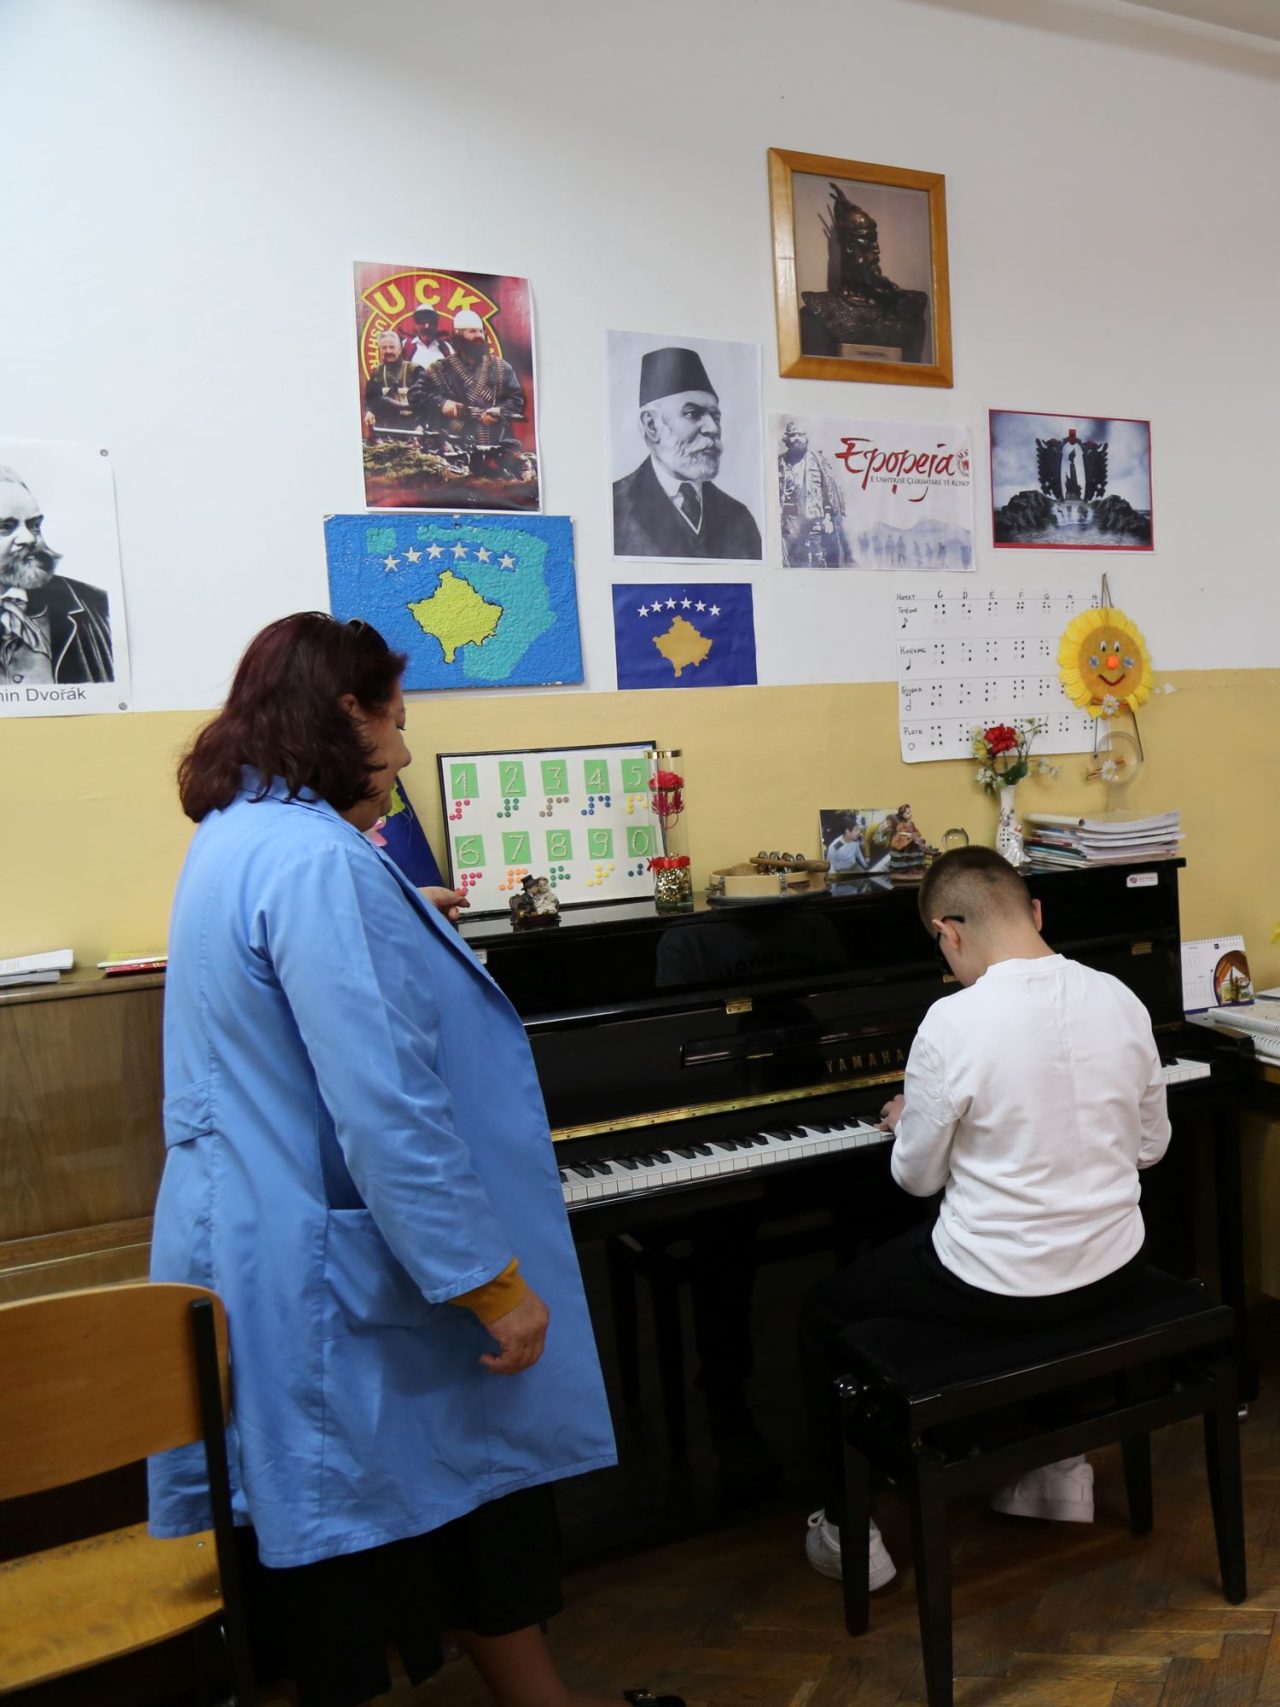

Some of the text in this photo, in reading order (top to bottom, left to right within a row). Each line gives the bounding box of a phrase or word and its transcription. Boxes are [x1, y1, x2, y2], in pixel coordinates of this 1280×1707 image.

[373, 277, 481, 315] UCK
[367, 319, 388, 370] USHTR
[834, 436, 955, 503] Epopeja
[962, 591, 969, 600] D
[1019, 592, 1024, 600] F
[26, 686, 87, 702] Dvořák
[455, 765, 643, 797] 1 2 3 4 5
[458, 829, 649, 866] 6 7 8 9 0
[824, 1048, 905, 1073] YAMAHA
